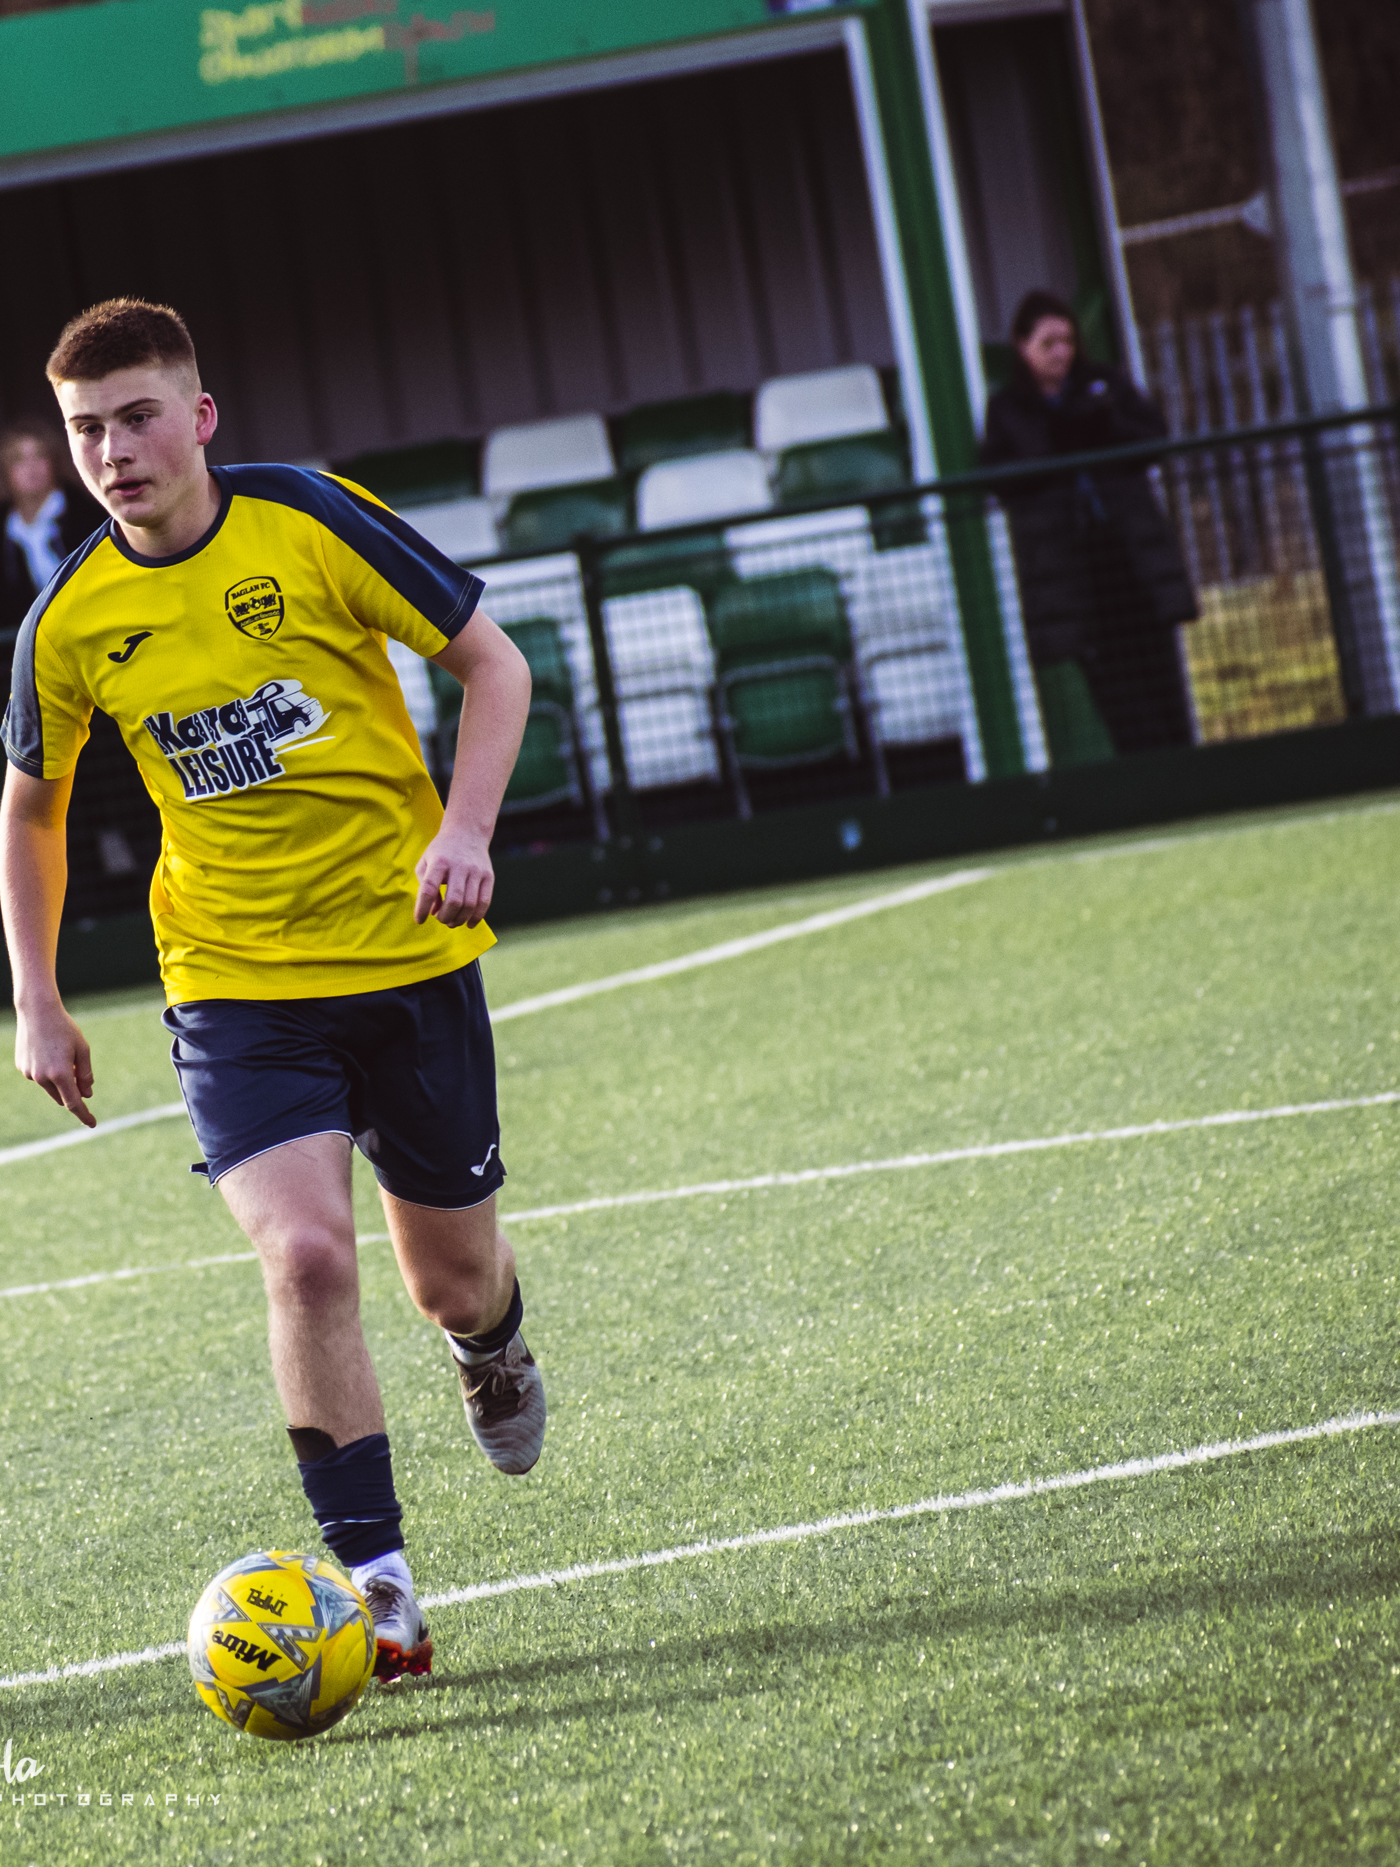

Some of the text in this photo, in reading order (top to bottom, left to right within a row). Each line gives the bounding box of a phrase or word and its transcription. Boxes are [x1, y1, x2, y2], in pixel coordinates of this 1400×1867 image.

[231, 584, 260, 600] BAGLAN
[168, 731, 286, 799] LEISURE
[211, 1630, 283, 1672] Mitre
